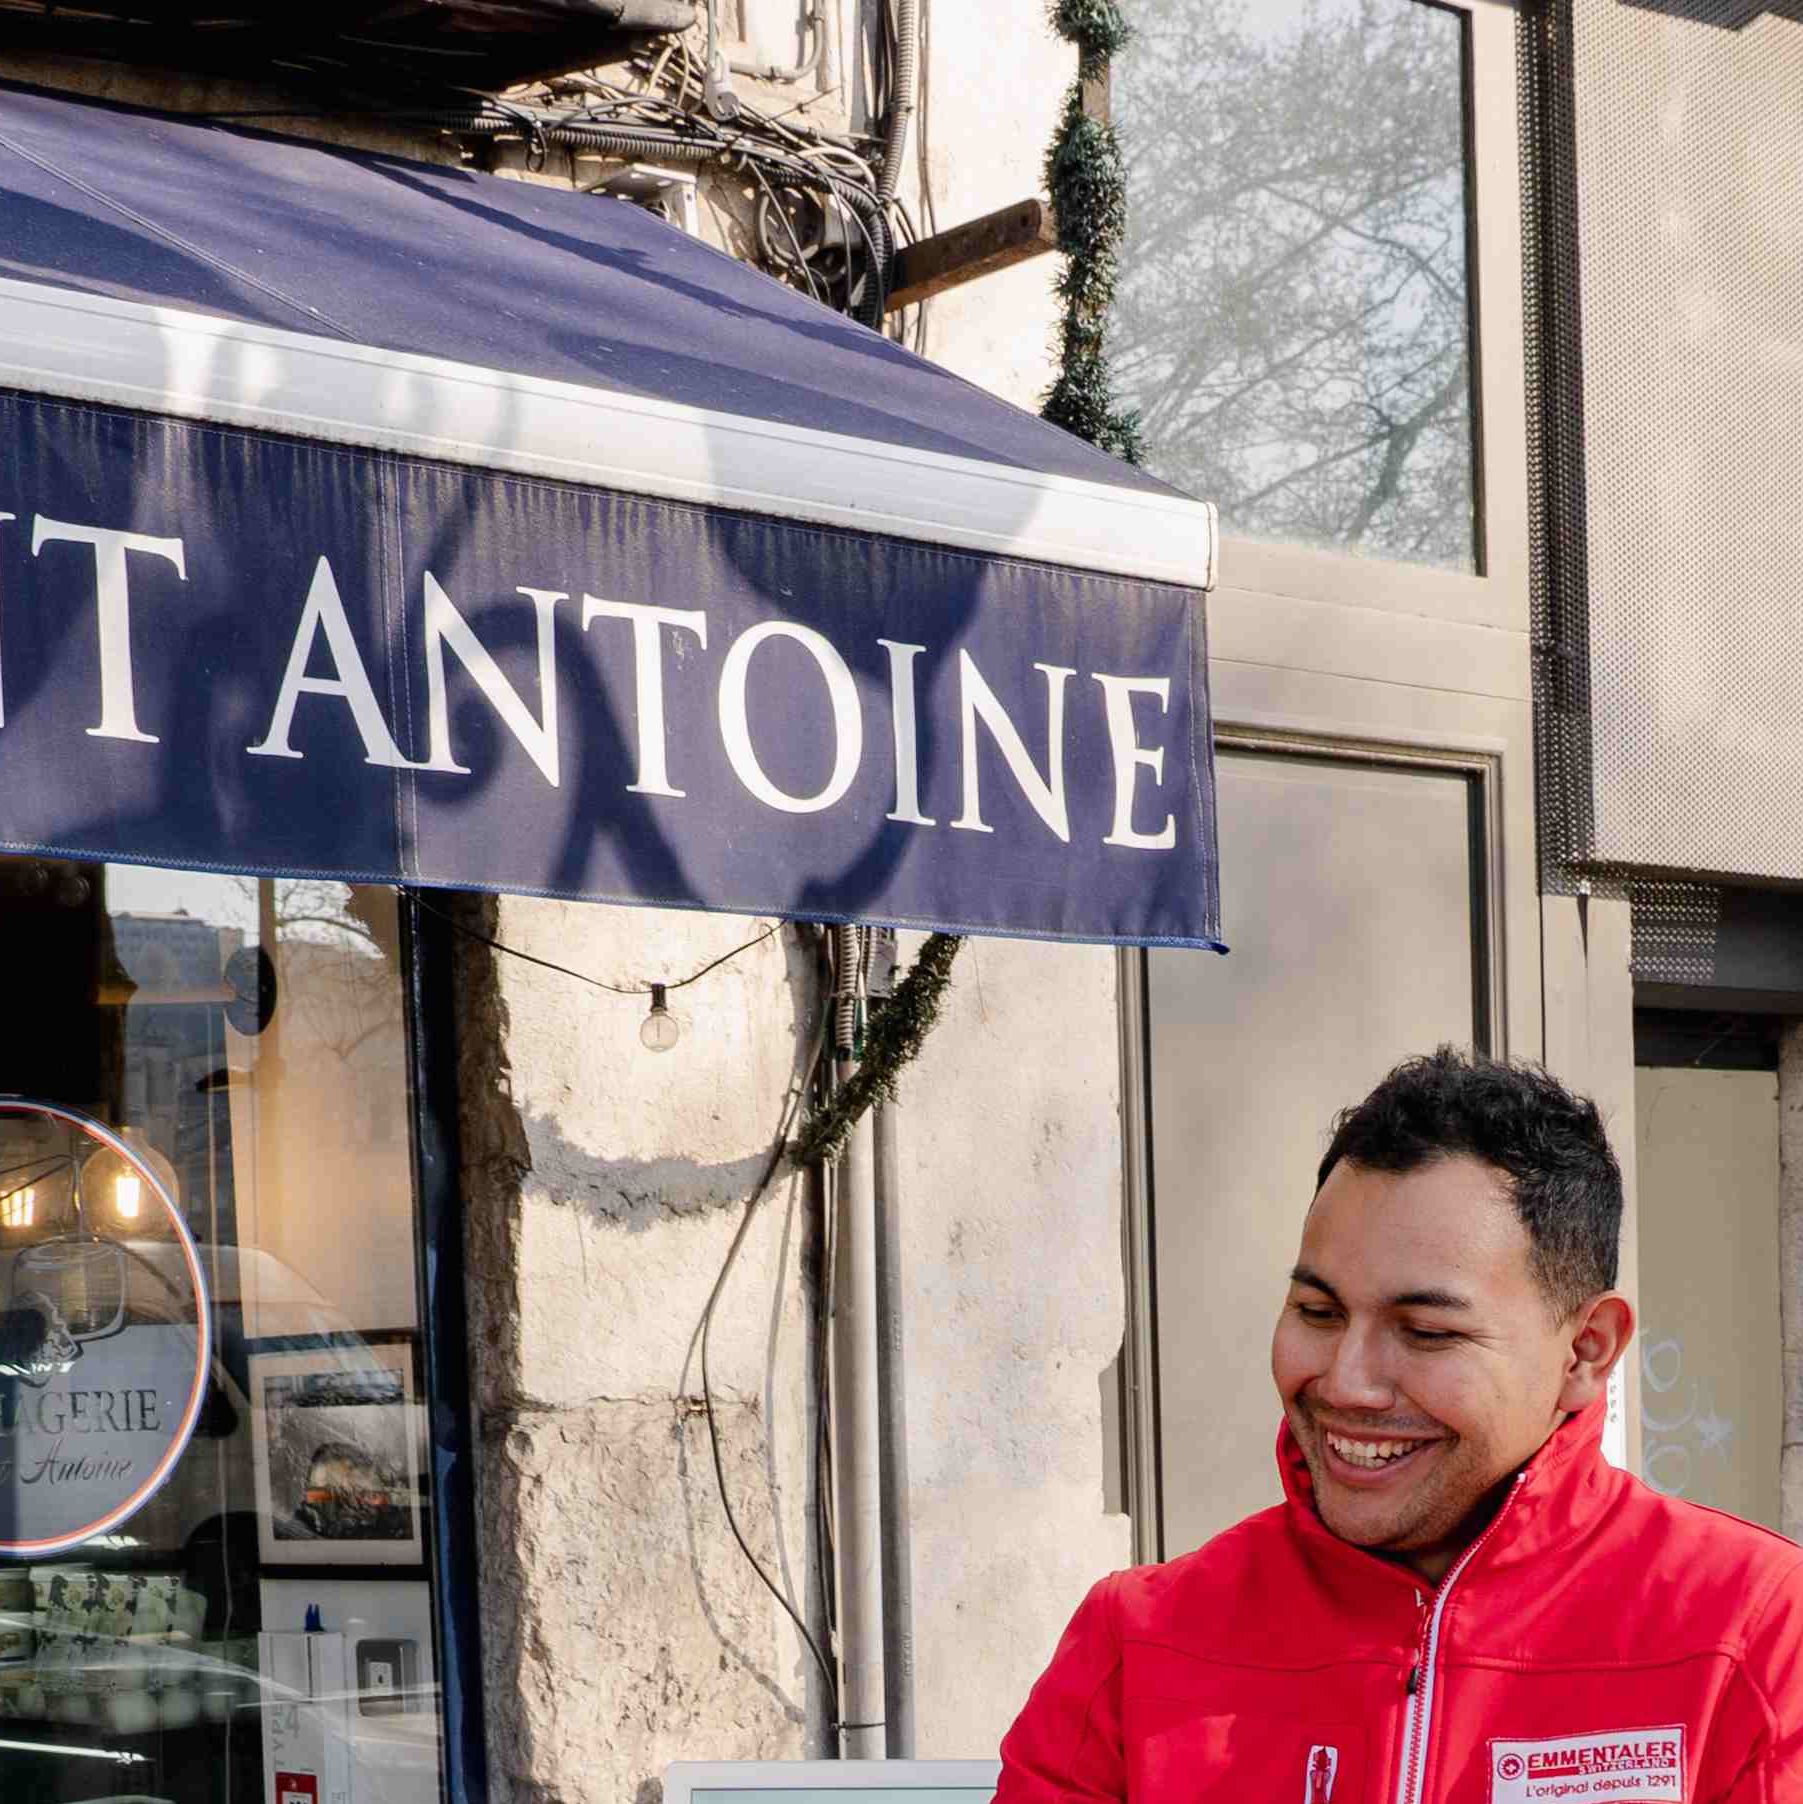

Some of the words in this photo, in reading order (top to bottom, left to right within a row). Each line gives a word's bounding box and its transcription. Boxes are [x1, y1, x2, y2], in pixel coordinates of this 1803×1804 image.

[245, 555, 1178, 852] ANTOINE
[20, 1438, 134, 1486] Antoine
[1527, 1741, 1677, 1770] EMMENTALER
[1577, 1758, 1670, 1776] SWITZERLAND
[1525, 1781, 1590, 1799] L'original
[1592, 1775, 1642, 1793] depuis
[1647, 1774, 1677, 1788] 1291
